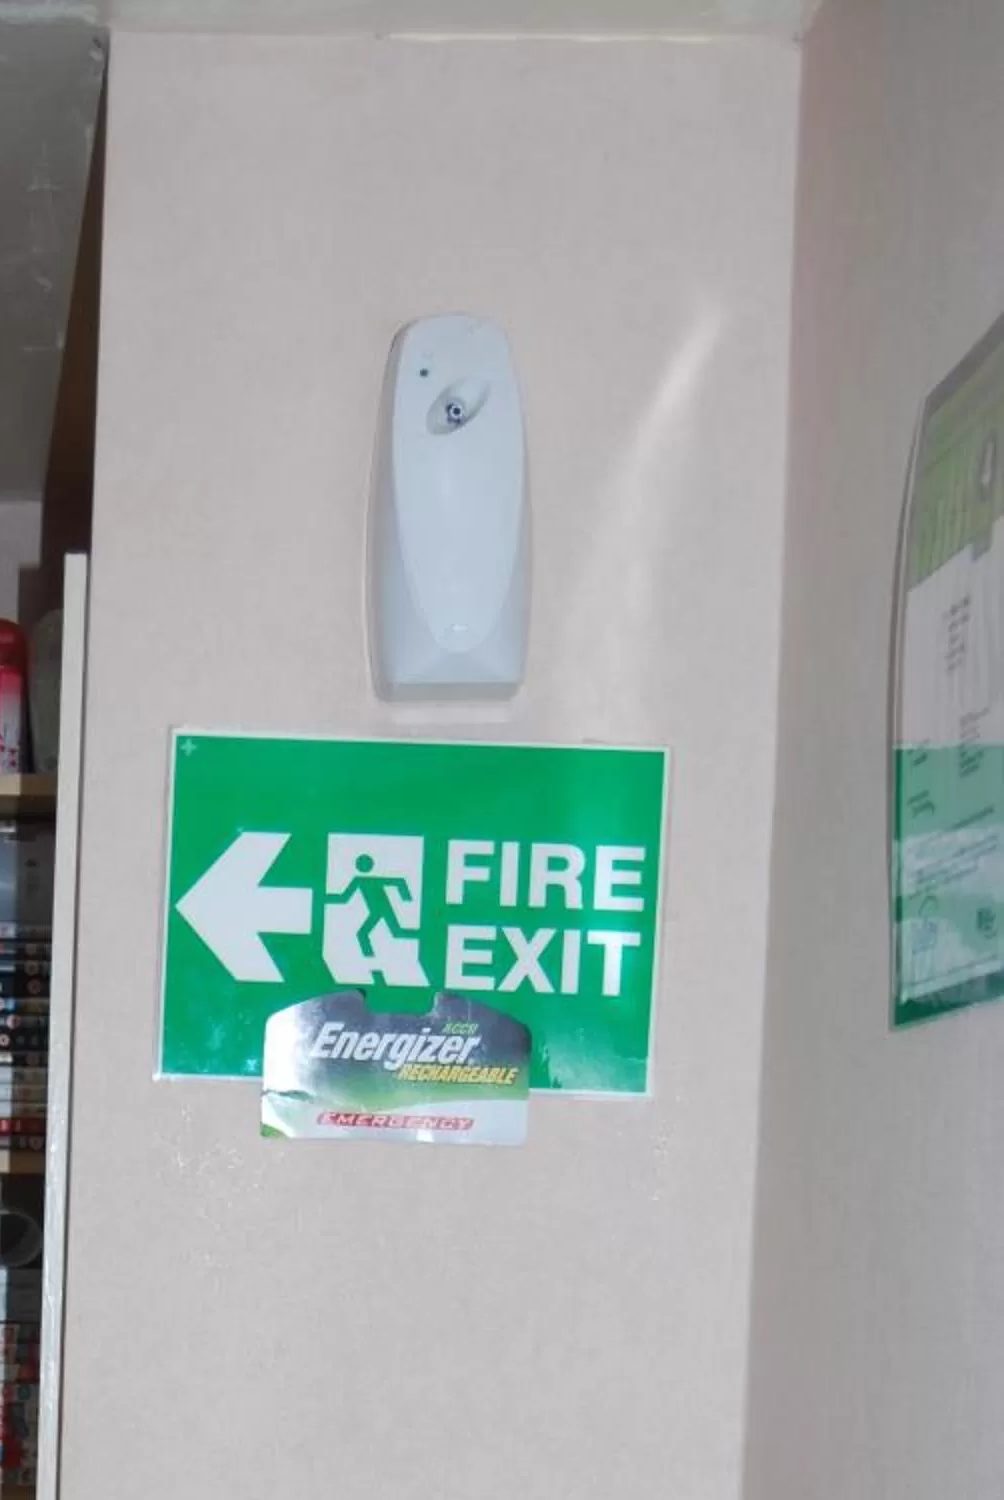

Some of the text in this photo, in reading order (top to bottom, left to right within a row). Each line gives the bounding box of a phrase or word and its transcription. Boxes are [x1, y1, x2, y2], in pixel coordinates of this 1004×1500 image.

[446, 840, 646, 912] FIRE
[445, 925, 641, 997] EXIT
[310, 1021, 481, 1070] Energizer
[397, 1063, 519, 1085] RECHARGEABLE
[320, 1112, 472, 1130] EMERGENCY
